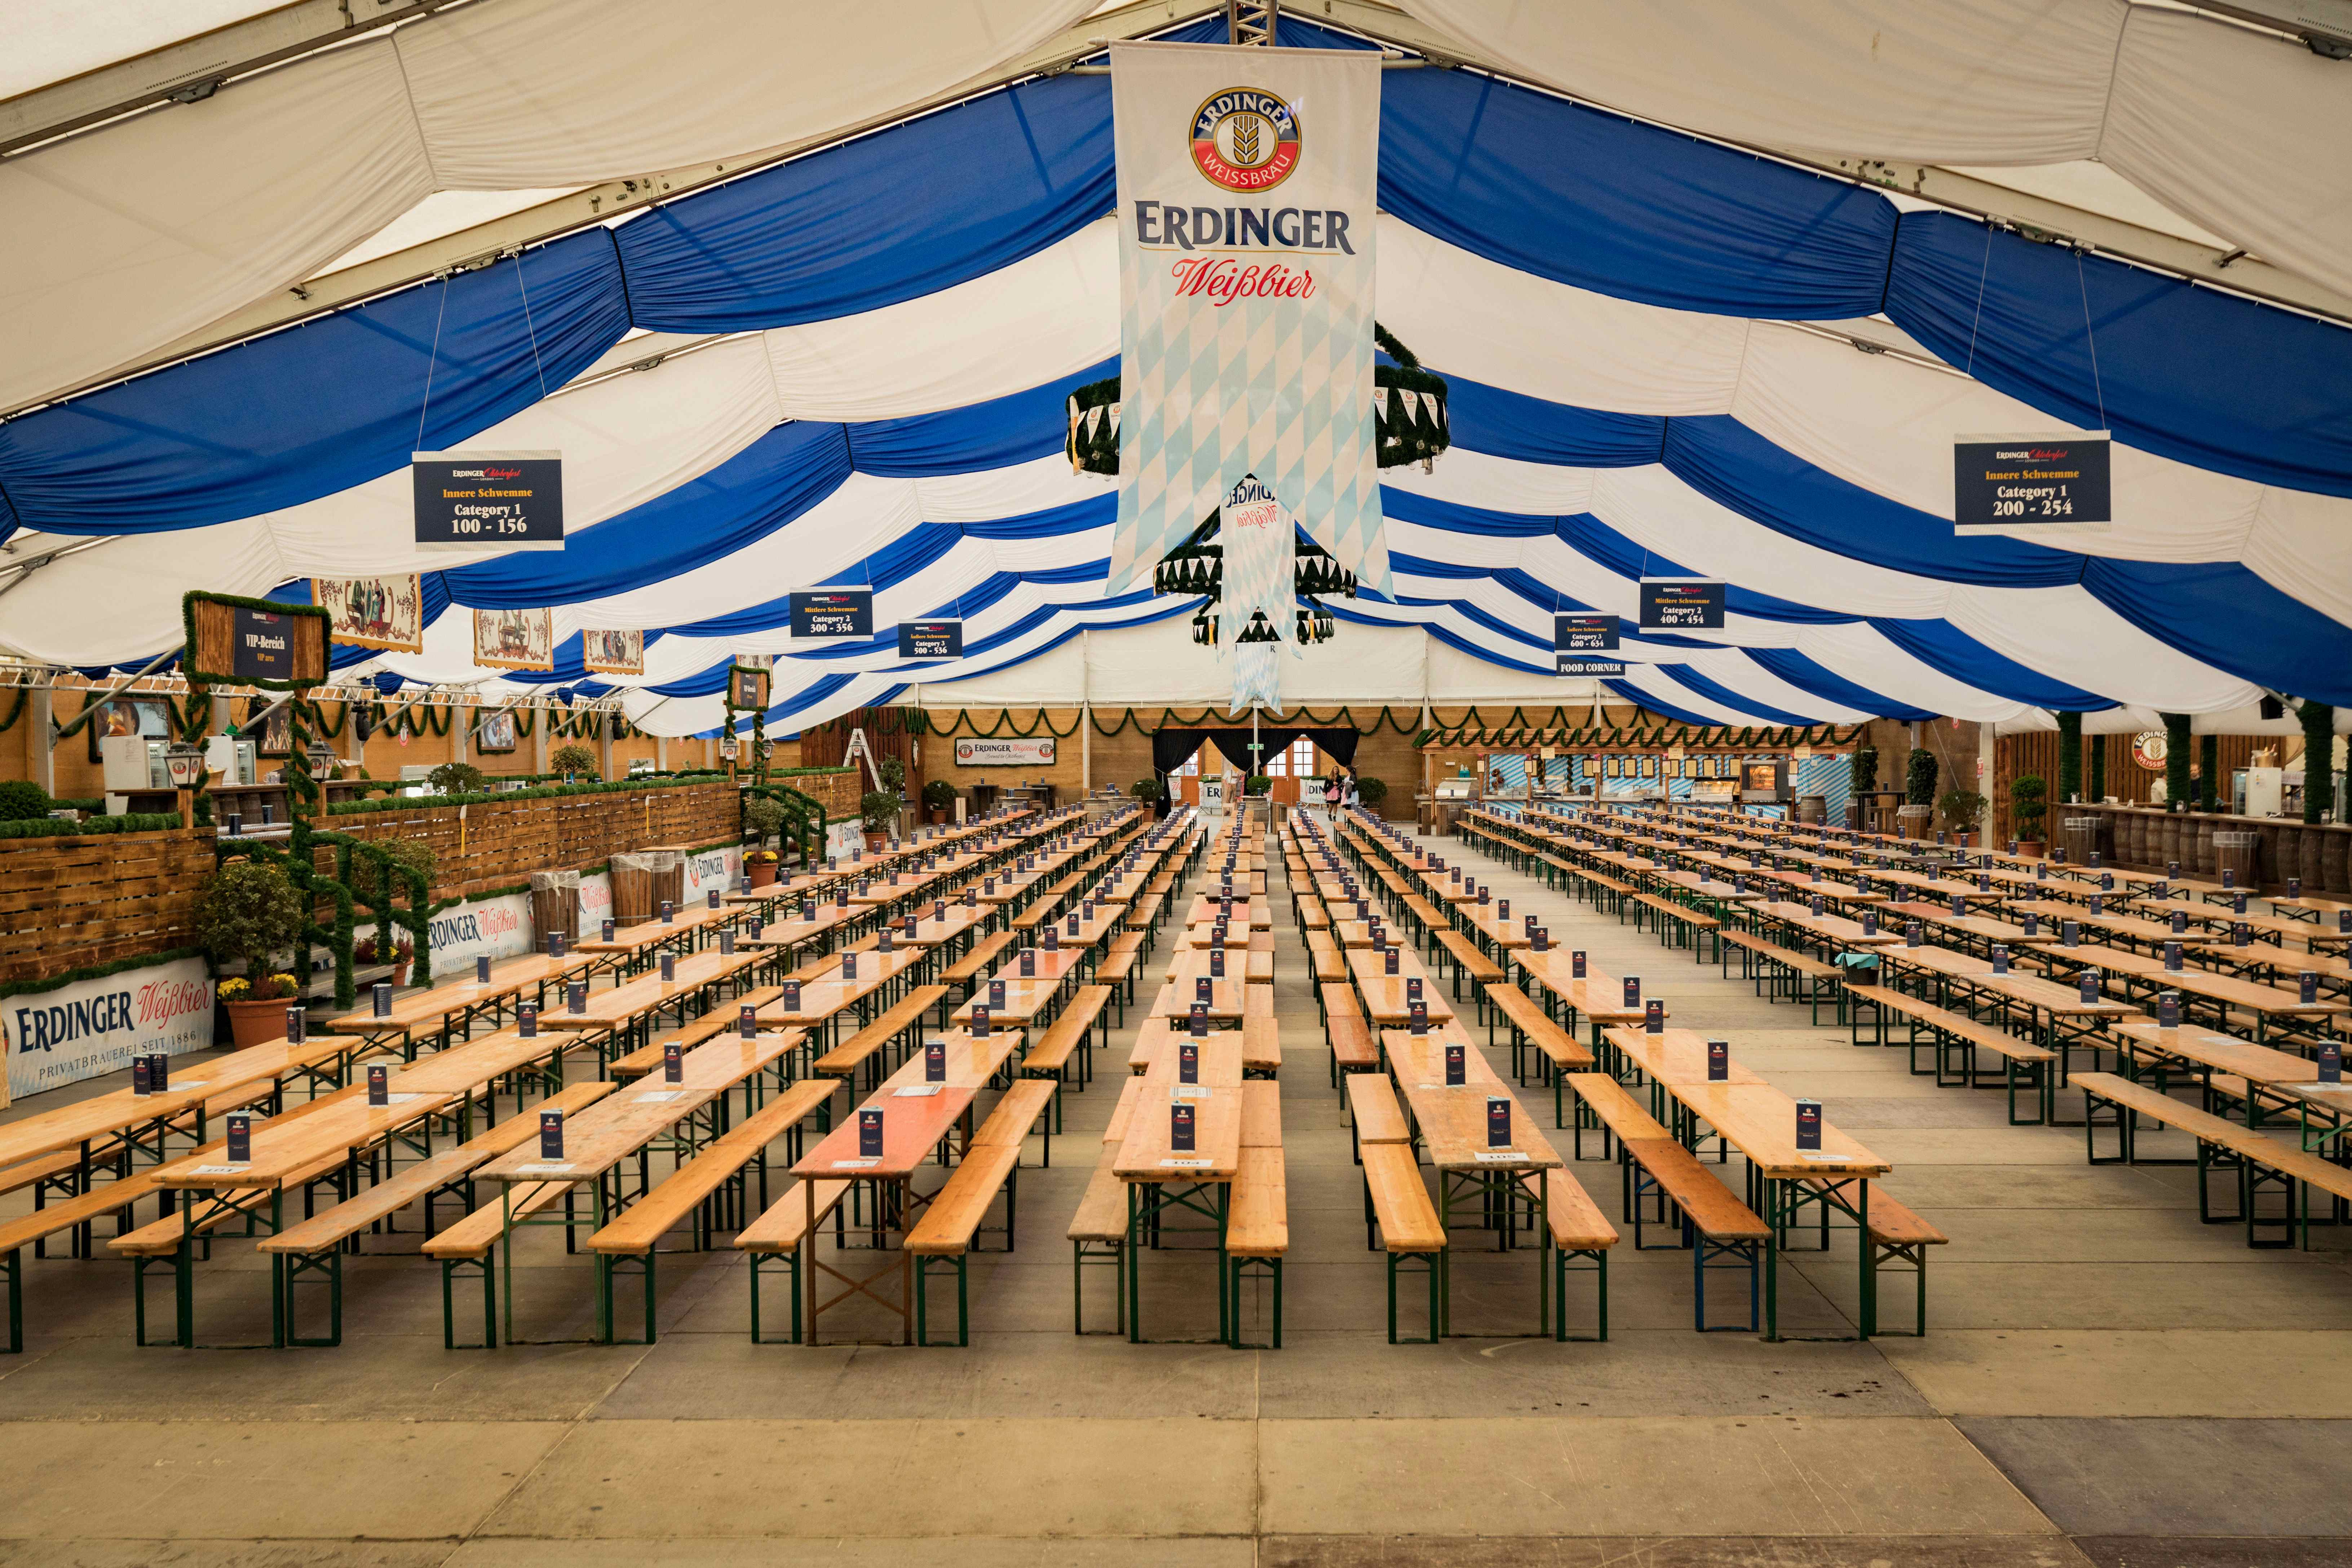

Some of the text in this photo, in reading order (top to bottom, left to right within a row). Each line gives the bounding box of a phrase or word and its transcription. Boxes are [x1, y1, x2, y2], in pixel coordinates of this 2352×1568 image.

[1197, 94, 1294, 134] ERDINGER
[1204, 154, 1290, 185] WEISSBRÄU
[1134, 200, 1356, 255] ERDINGER
[1172, 257, 1317, 306] Weißbier
[483, 467, 521, 481] Oktoberfest
[1986, 469, 2079, 480] Innere Schwemme
[443, 488, 532, 498] Innere Schwemme
[1997, 485, 2066, 500] Category 1
[455, 504, 521, 518] Category 1
[1993, 501, 2024, 516] 200
[2042, 498, 2073, 516] 254
[452, 518, 480, 533] 100
[498, 517, 527, 534] 156
[1660, 615, 1678, 624] 400
[1686, 615, 1704, 624] 454
[810, 623, 827, 633] 300
[836, 623, 853, 632] 356
[246, 634, 285, 650] VIP-Bereich
[1561, 663, 1621, 672] FOOD CORNER
[2135, 731, 2167, 746] ERDING
[975, 744, 1038, 753] ERDINGER Weißbier
[2137, 754, 2166, 767] WEISSBR
[478, 907, 518, 941] Weißbier
[487, 947, 499, 956] SEIT
[15, 980, 210, 1054] ERDINGER Weißbier
[39, 1044, 137, 1080] PRIVATBRAUEREI
[142, 1037, 165, 1052] SEIT
[171, 1031, 196, 1046] 1886
